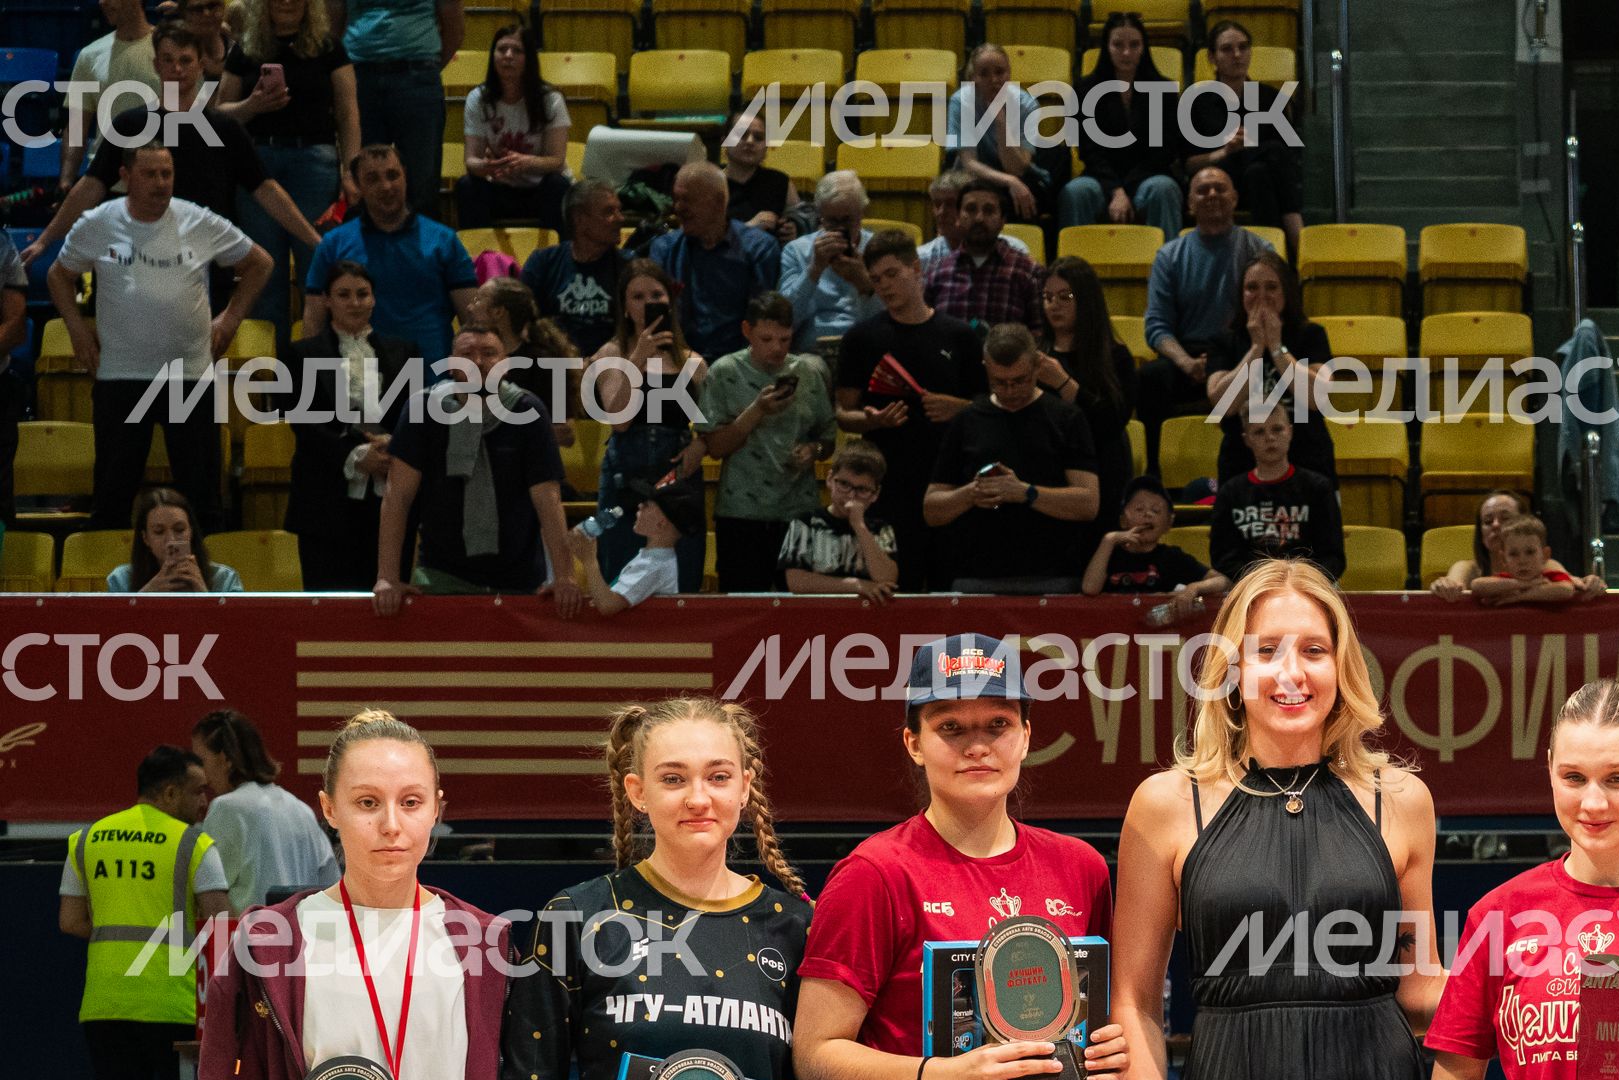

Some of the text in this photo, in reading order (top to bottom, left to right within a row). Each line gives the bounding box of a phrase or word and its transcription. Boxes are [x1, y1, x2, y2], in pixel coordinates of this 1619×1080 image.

[560, 299, 609, 317] Kappa
[1232, 505, 1309, 524] DREAM
[1238, 521, 1300, 540] TEAM
[91, 829, 167, 844] STEWARD
[115, 859, 155, 880] 113
[923, 901, 955, 917] АСБ
[1505, 938, 1539, 955] АСБ
[761, 955, 784, 972] РФБ
[951, 954, 970, 962] CITY
[1531, 1050, 1562, 1064] ЛИГА
